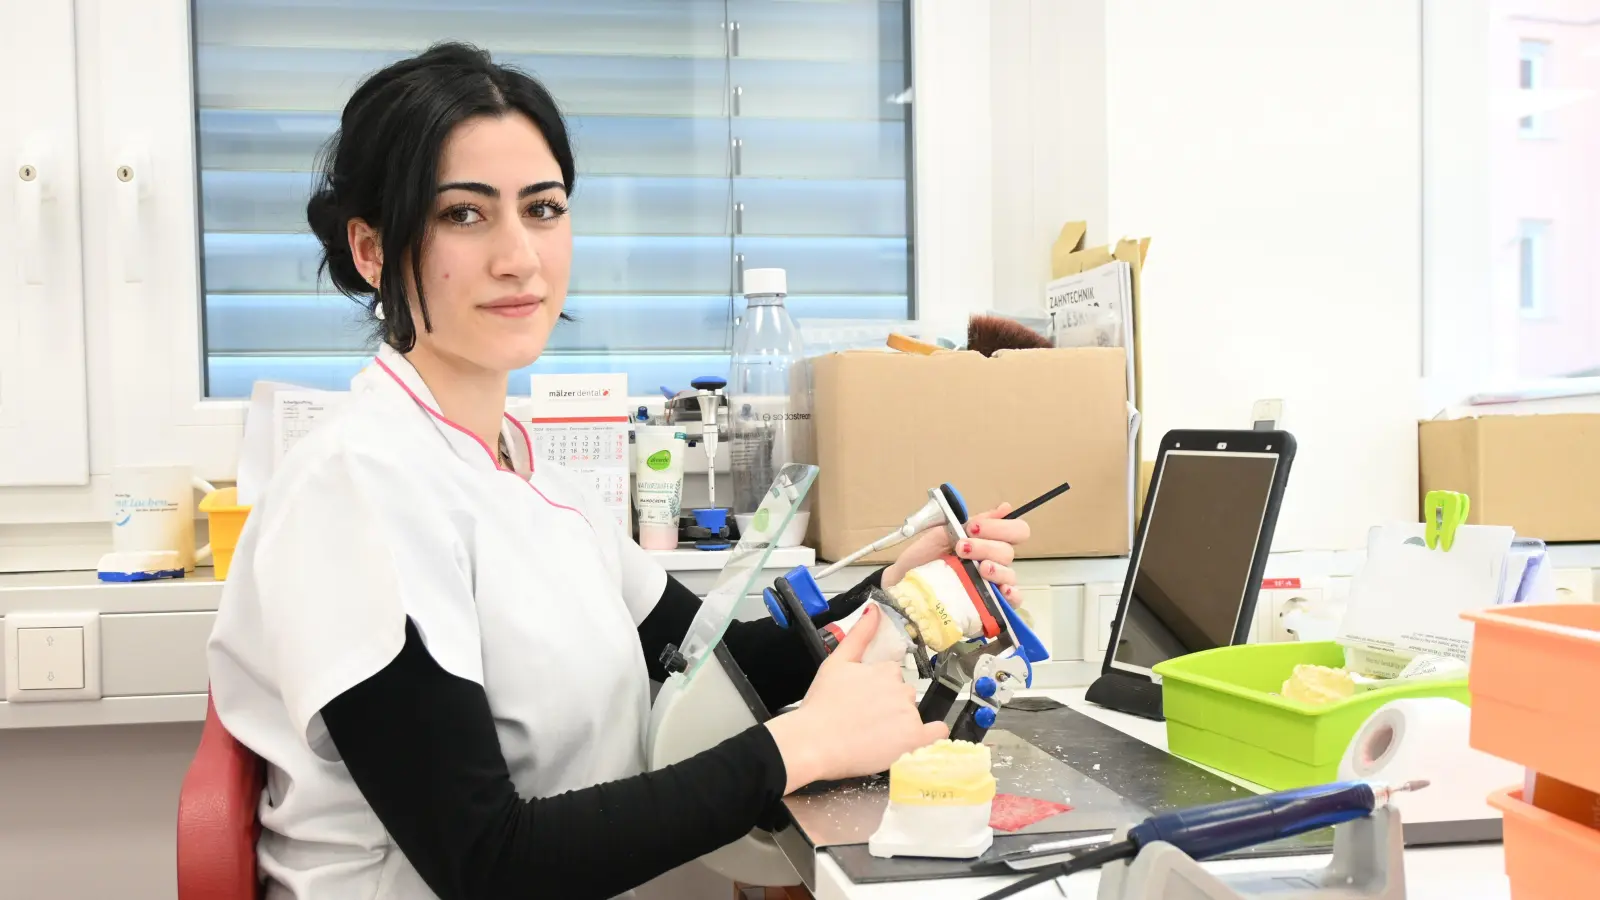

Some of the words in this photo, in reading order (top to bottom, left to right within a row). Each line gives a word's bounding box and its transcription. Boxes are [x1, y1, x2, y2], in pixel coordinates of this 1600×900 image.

[1049, 286, 1095, 309] ZAHNTECHNIK
[548, 389, 576, 397] mälzer
[576, 389, 601, 397] dental
[935, 602, 951, 626] 4306
